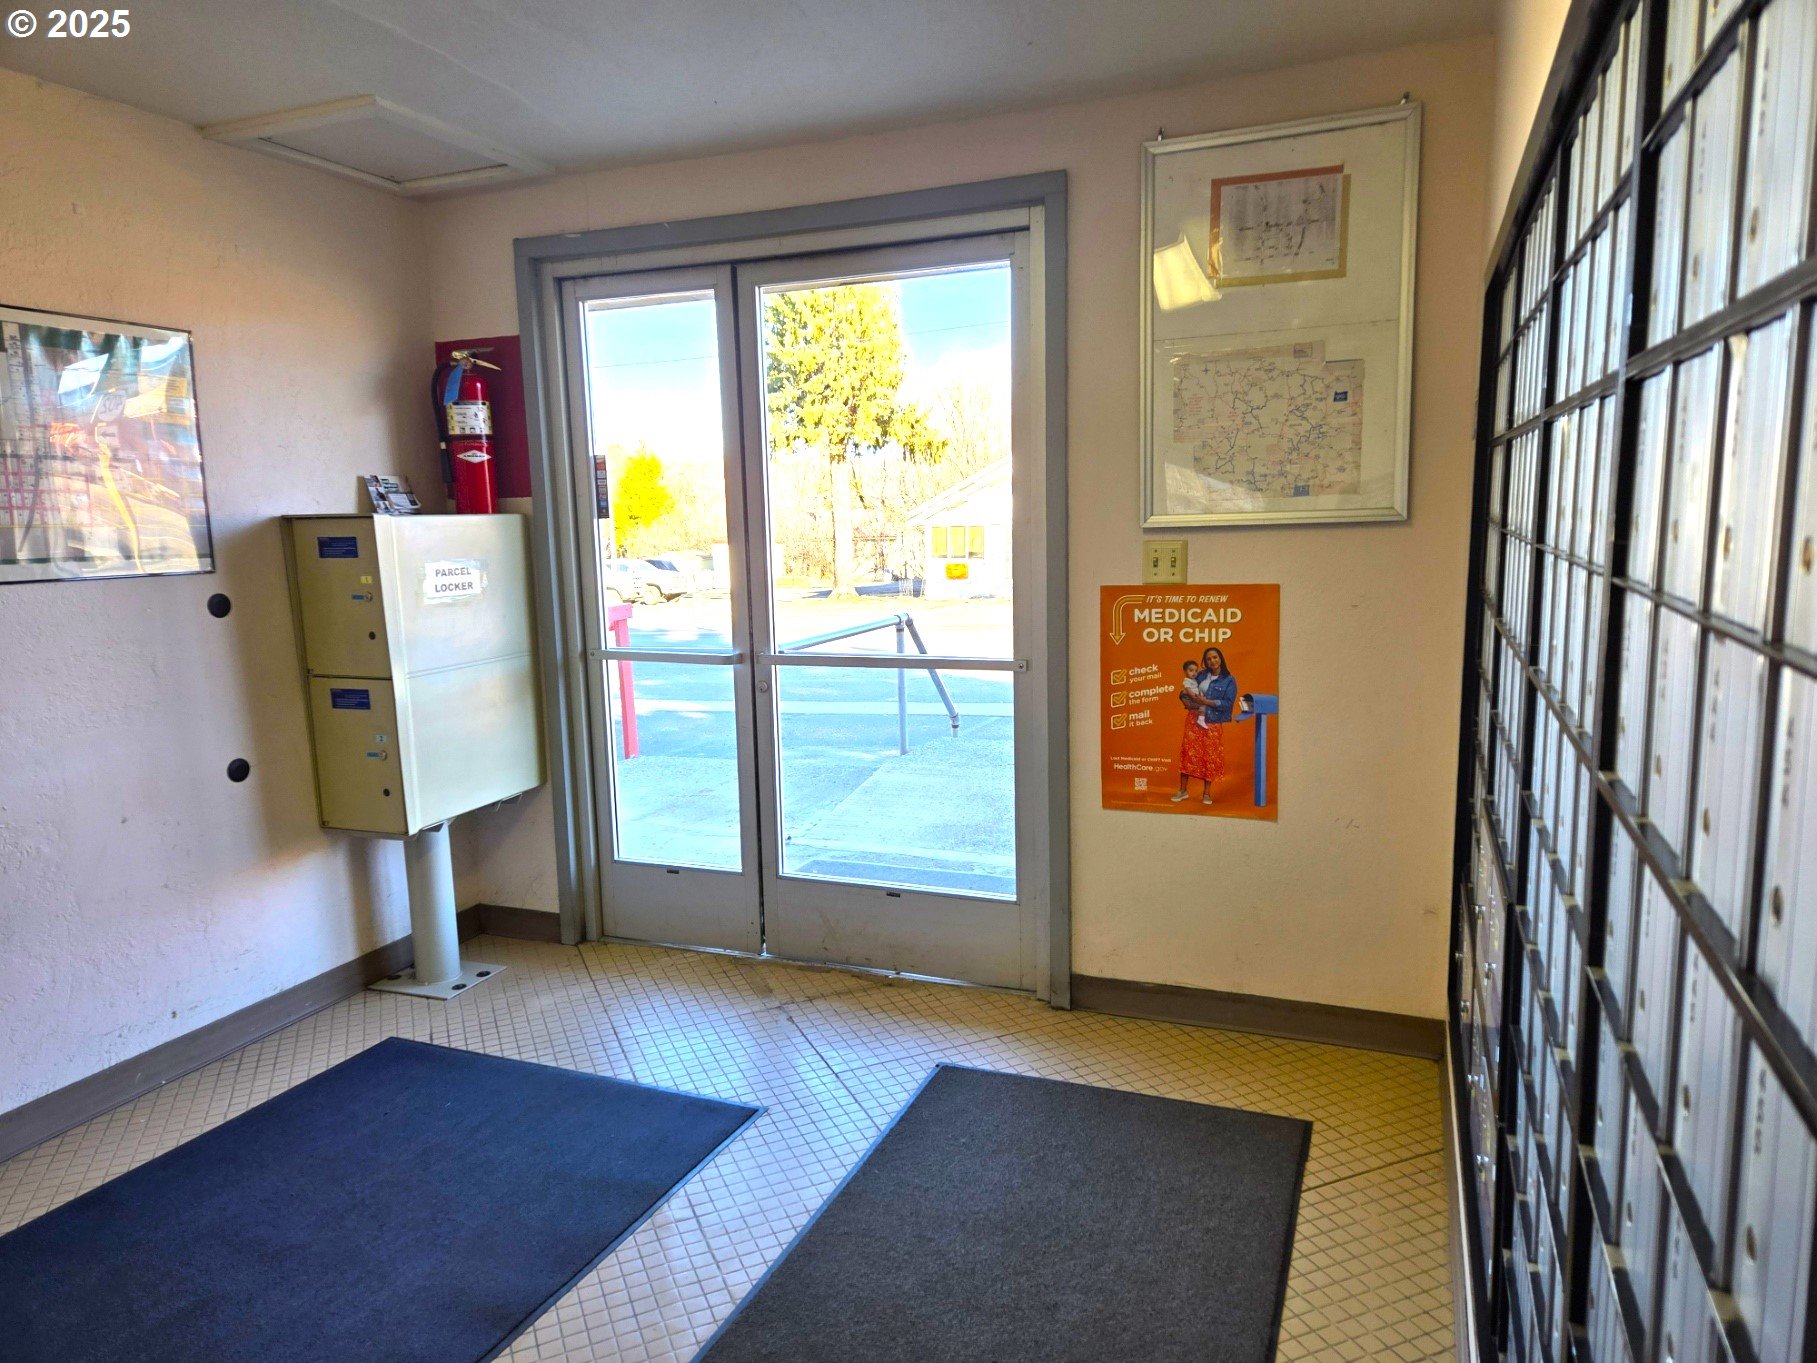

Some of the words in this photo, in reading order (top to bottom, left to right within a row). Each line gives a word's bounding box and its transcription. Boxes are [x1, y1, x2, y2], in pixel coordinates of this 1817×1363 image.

[435, 567, 472, 578] PARCEL
[434, 581, 474, 593] LOCKER
[1146, 595, 1162, 603] IT'S
[1165, 595, 1184, 603] TIME
[1187, 595, 1197, 603] TO
[1199, 595, 1228, 603] RENEW
[1134, 607, 1242, 624] MEDICAID
[1142, 627, 1174, 643] OR
[1179, 627, 1232, 643] CHIP
[1128, 664, 1159, 676] check
[1129, 676, 1146, 684] your
[1146, 672, 1162, 680] mail
[1128, 685, 1175, 698] complete
[1128, 698, 1141, 706] the
[1141, 696, 1159, 704] form
[1128, 710, 1150, 721] mail
[1129, 720, 1135, 728] it
[1135, 718, 1153, 726] back
[1113, 763, 1168, 773] HealthCare.gov
